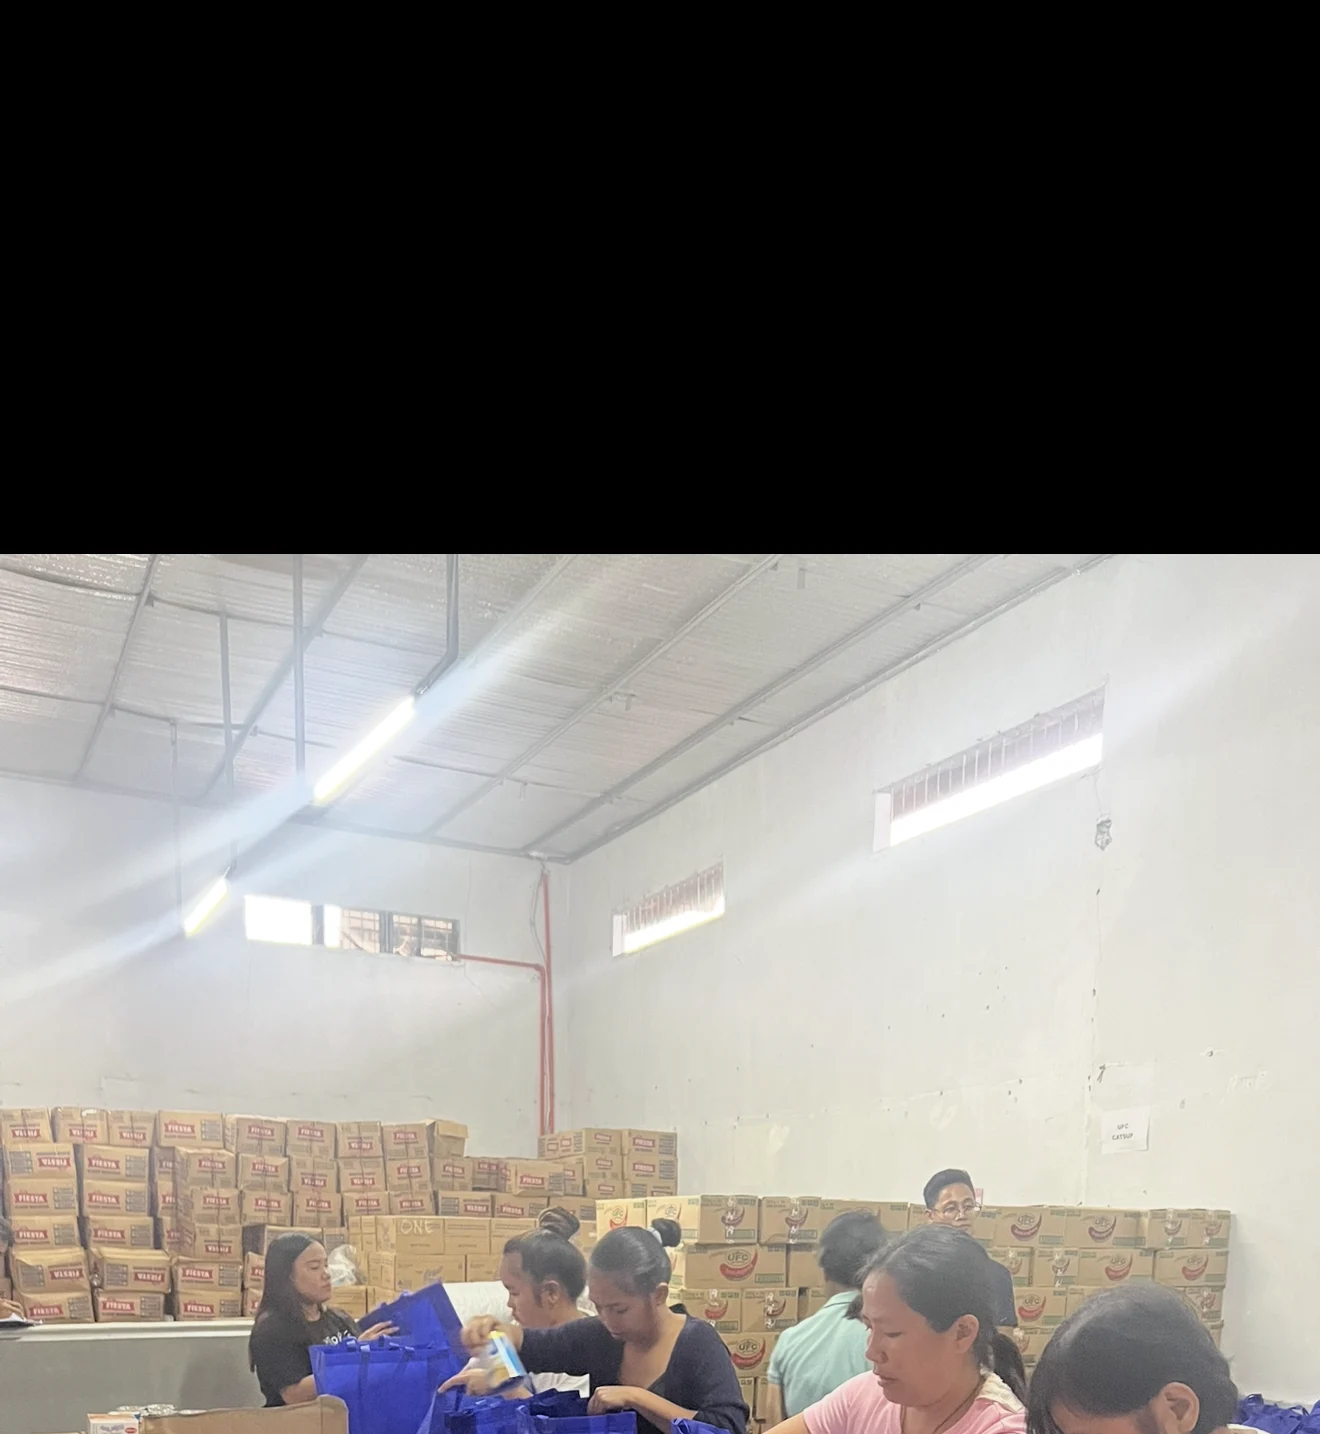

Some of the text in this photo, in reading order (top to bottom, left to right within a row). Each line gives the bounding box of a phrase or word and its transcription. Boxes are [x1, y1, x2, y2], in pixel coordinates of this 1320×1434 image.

[168, 1125, 193, 1134] FIESTA
[91, 1159, 117, 1168] FIESTA
[18, 1193, 46, 1203] FIESTA
[91, 1194, 117, 1203] FIESTA
[400, 1218, 434, 1236] ONE
[18, 1230, 46, 1239] FIESTA
[97, 1229, 122, 1239] FIESTA
[727, 1252, 749, 1262] UFC
[185, 1269, 210, 1279] FIESTA
[33, 1306, 60, 1315] FIESTA
[105, 1301, 132, 1311] FIESTA
[187, 1304, 213, 1313] FIESTA
[737, 1342, 758, 1352] UFC
